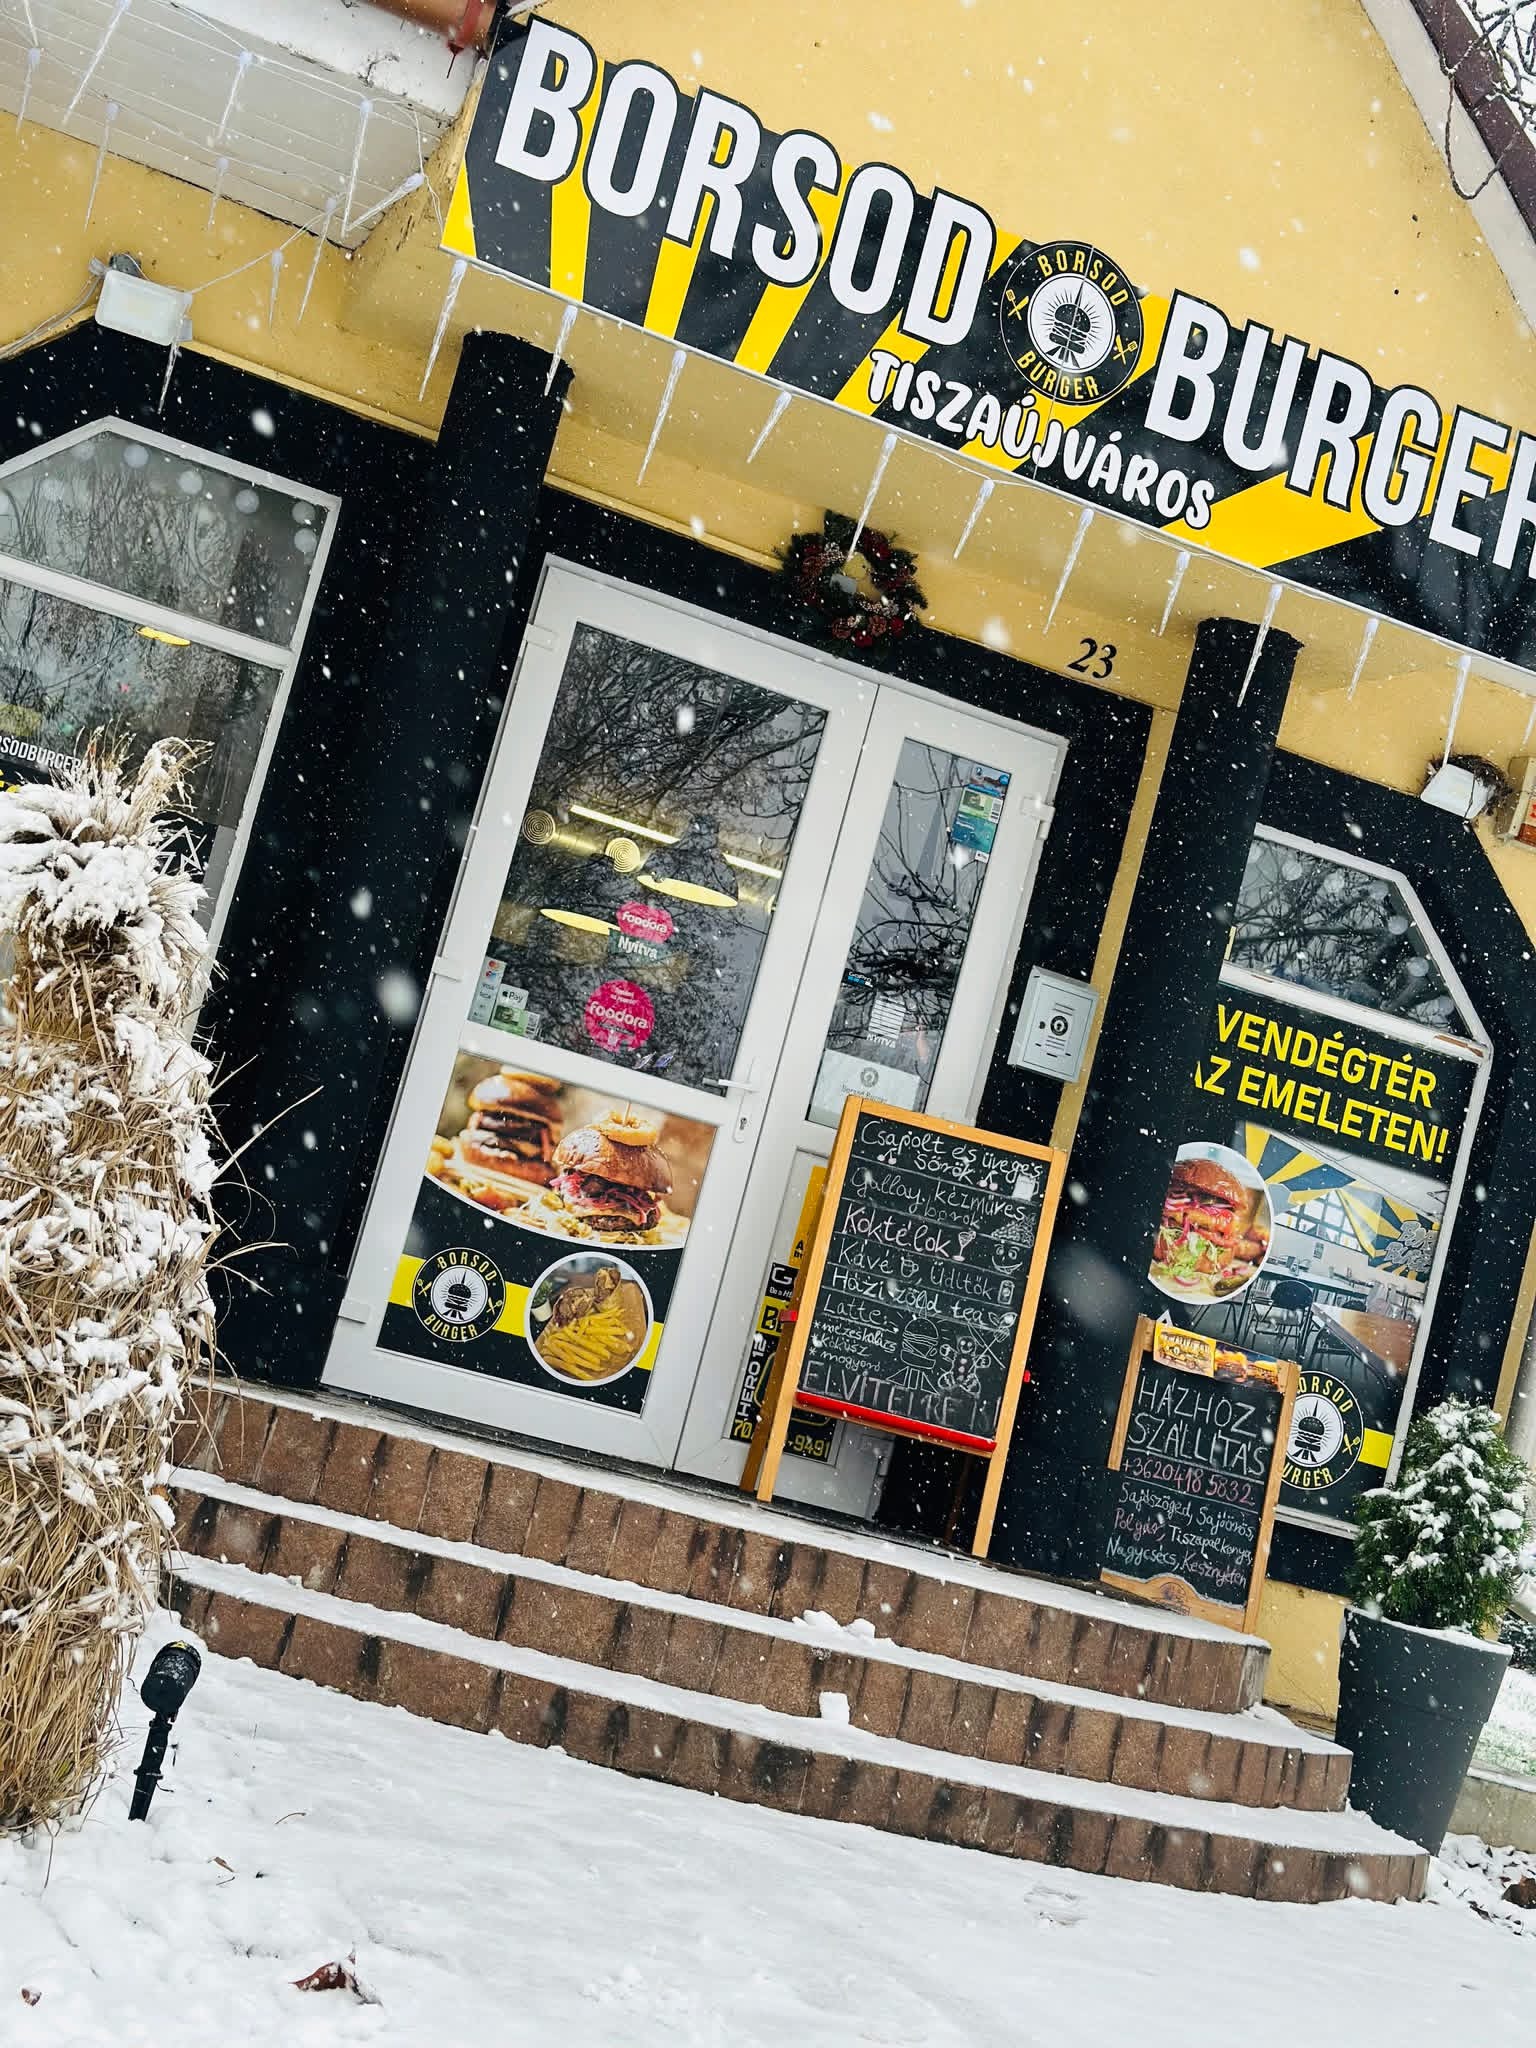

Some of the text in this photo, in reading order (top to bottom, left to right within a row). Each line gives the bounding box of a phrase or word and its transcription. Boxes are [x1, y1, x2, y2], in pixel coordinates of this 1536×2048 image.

[493, 17, 997, 346] BORSOD
[1037, 249, 1129, 306] BORSOD
[1016, 350, 1099, 400] BURGER
[869, 350, 1215, 529] TISZAÚJVÁROS
[1067, 637, 1117, 679] 23
[622, 911, 667, 934] foodora
[618, 936, 658, 961] Nyitva
[508, 991, 523, 1003] Pay
[589, 1001, 649, 1029] foodora
[1217, 1004, 1437, 1109] VENDÉGTÉR
[1237, 1065, 1449, 1164] EMELETEN!
[861, 1119, 1043, 1184] Csapolt és üveges
[841, 1203, 951, 1258] Koktélok
[924, 1194, 980, 1230] borok
[437, 1251, 497, 1281] BORSOD
[838, 1238, 893, 1274] Kávé
[424, 1313, 478, 1341] BURGER
[736, 1361, 761, 1418] HERO
[1138, 1375, 1257, 1438] HÁZHOZ
[1296, 1375, 1354, 1413] ORSOD
[1282, 1461, 1334, 1487] URGER
